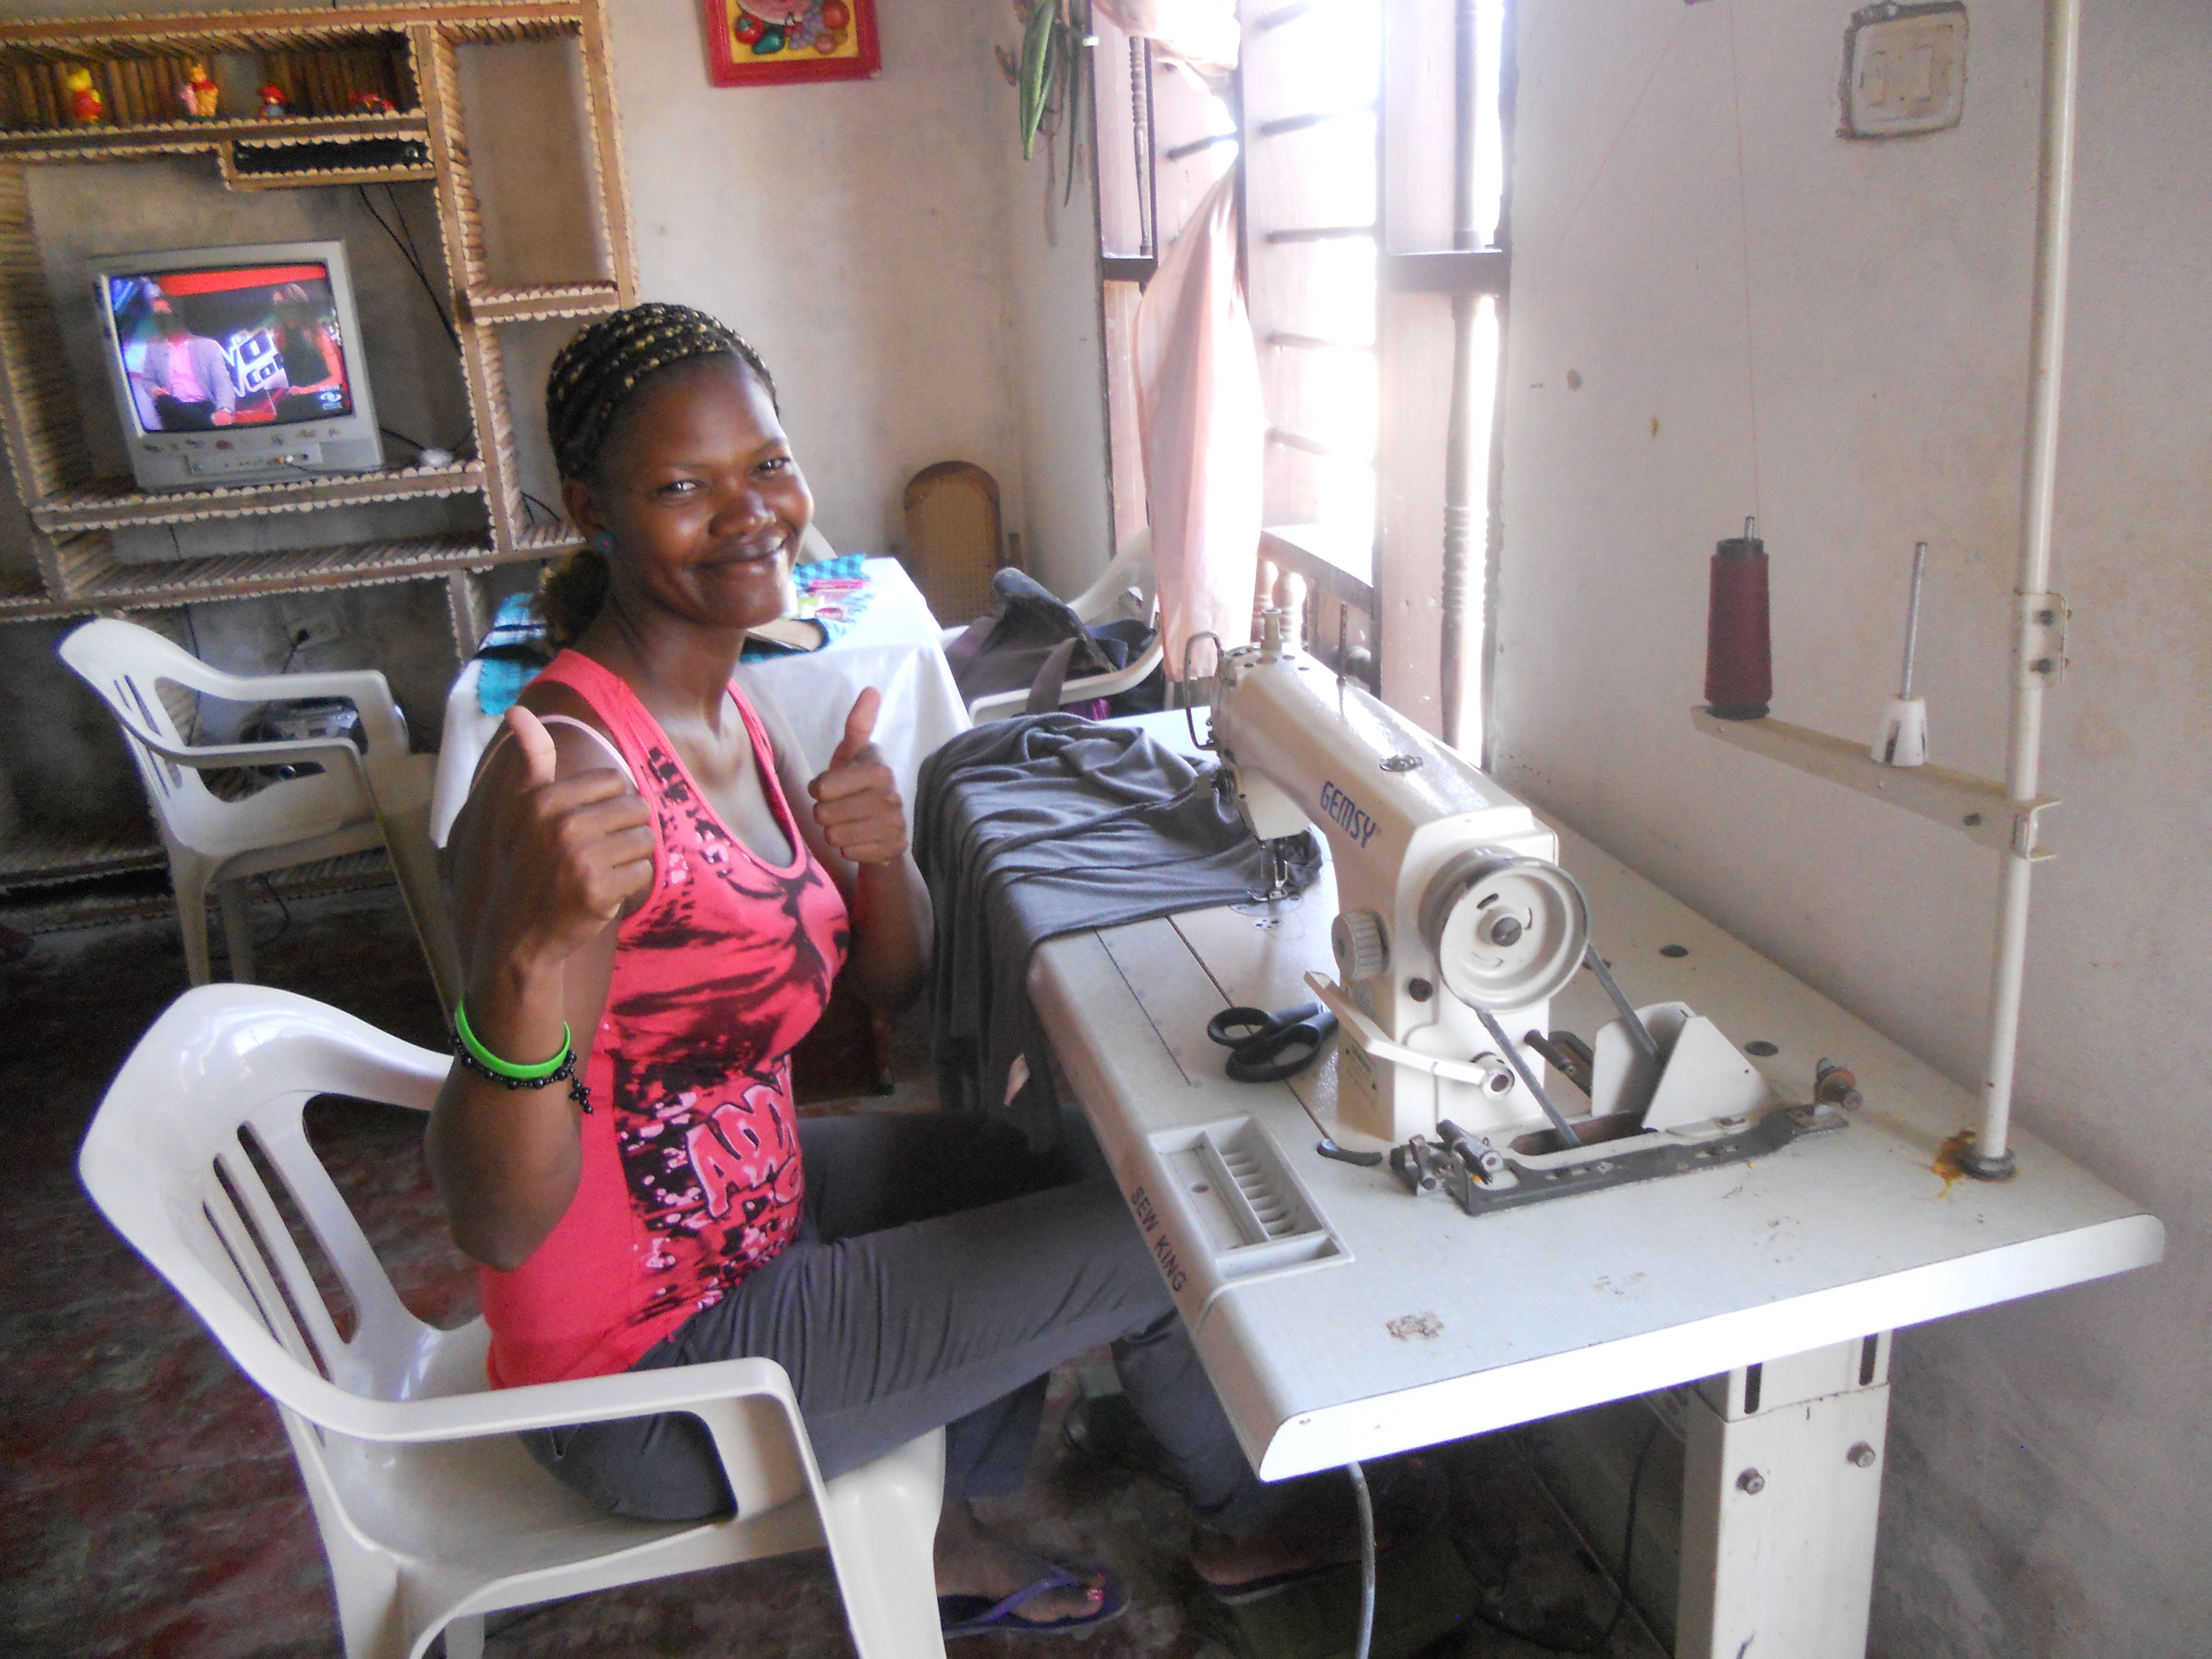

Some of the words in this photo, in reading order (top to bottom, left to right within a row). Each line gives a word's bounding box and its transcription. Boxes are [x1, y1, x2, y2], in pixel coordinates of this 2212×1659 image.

[1320, 780, 1378, 849] GEMSY
[1131, 1186, 1159, 1233] SEW
[1155, 1234, 1187, 1292] KING
